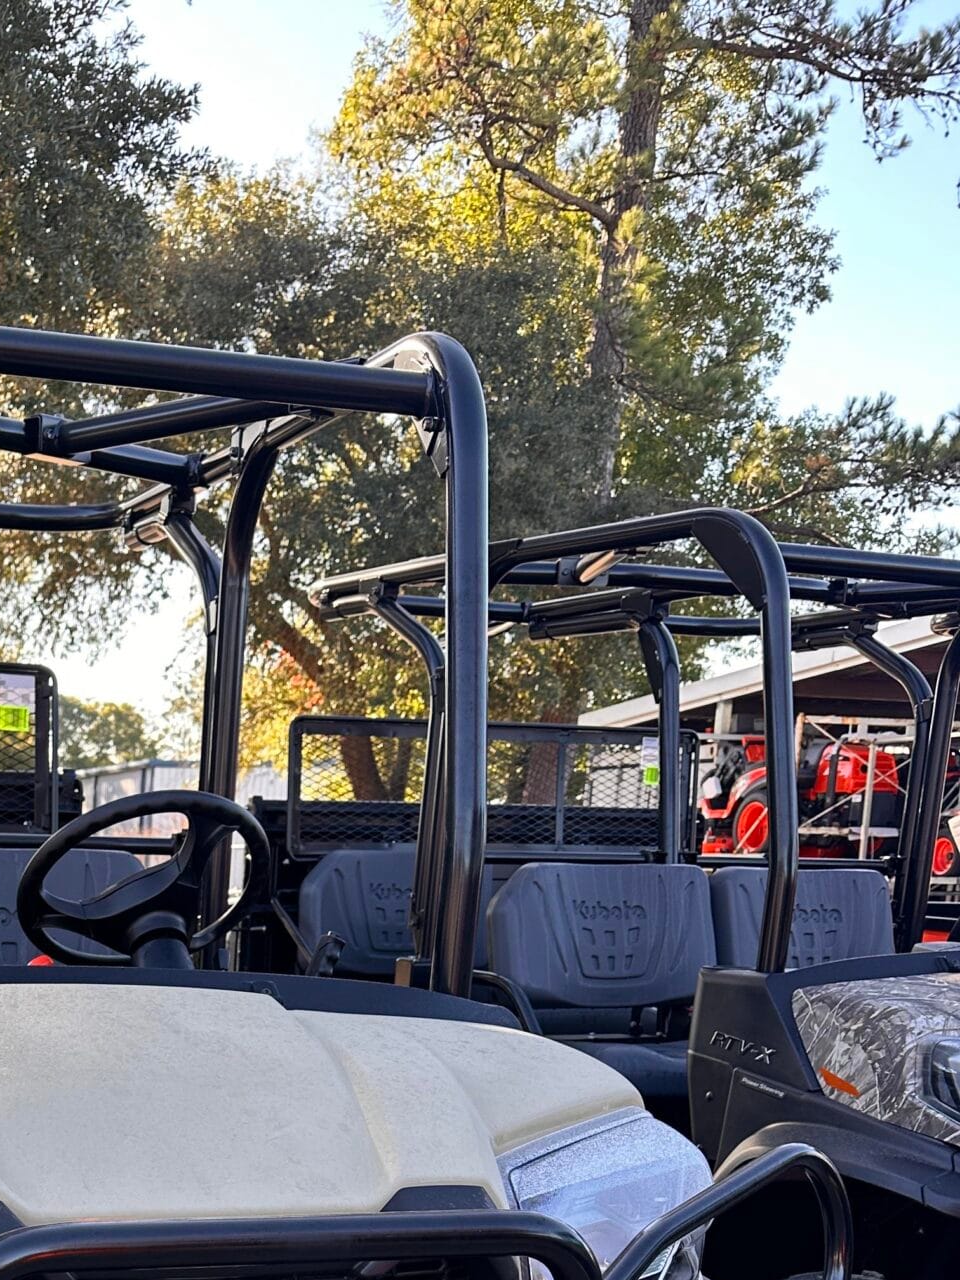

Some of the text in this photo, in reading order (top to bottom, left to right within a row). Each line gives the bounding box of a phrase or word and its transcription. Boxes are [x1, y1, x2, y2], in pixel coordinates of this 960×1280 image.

[369, 882, 413, 901] Kubo
[572, 899, 647, 921] Kubota
[795, 903, 843, 924] bota
[709, 1030, 776, 1065] RTV-X
